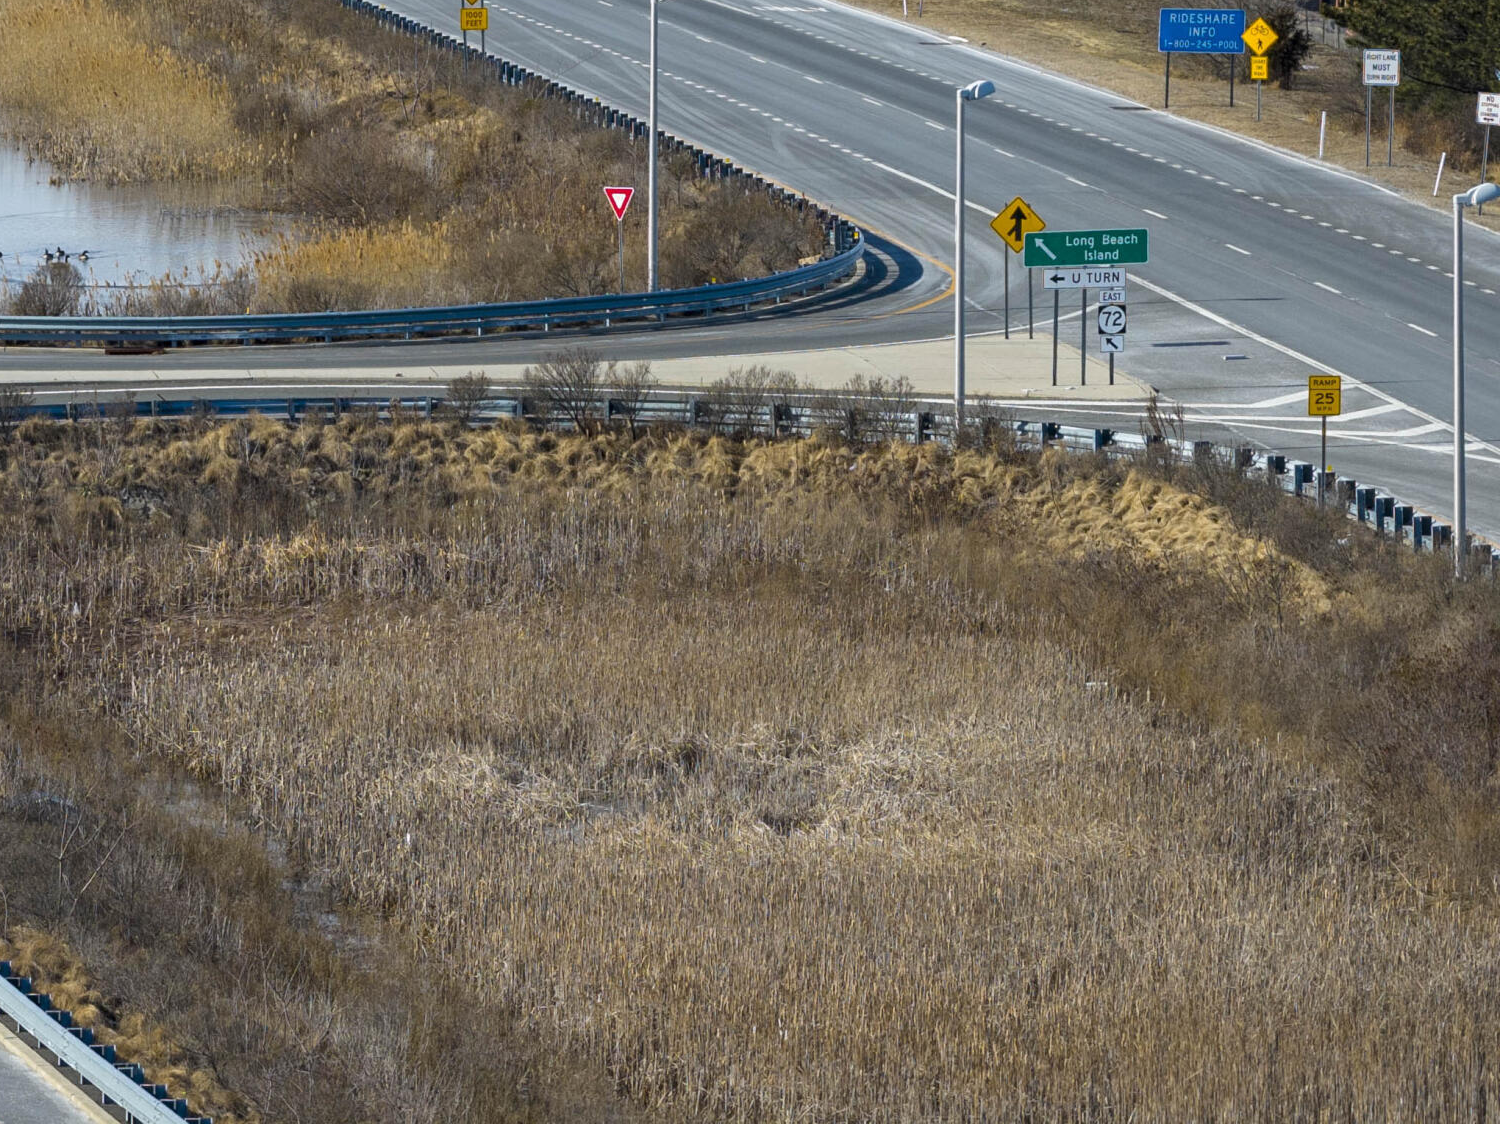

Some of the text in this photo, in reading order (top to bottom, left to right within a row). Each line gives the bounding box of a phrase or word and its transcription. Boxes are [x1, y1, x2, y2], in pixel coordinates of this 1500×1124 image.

[465, 11, 483, 19] 1000
[1169, 13, 1236, 24] RIDESHARE
[465, 19, 482, 27] FEET
[1189, 26, 1216, 37] INFO
[1164, 39, 1239, 50] 1-800-245-POOL
[1372, 63, 1391, 72] MUST
[1066, 234, 1138, 248] Long Beach
[1084, 250, 1120, 261] Island
[1072, 272, 1120, 284] U TURN
[1102, 292, 1122, 301] EAST
[1102, 311, 1123, 327] 72
[1315, 392, 1335, 405] 25
